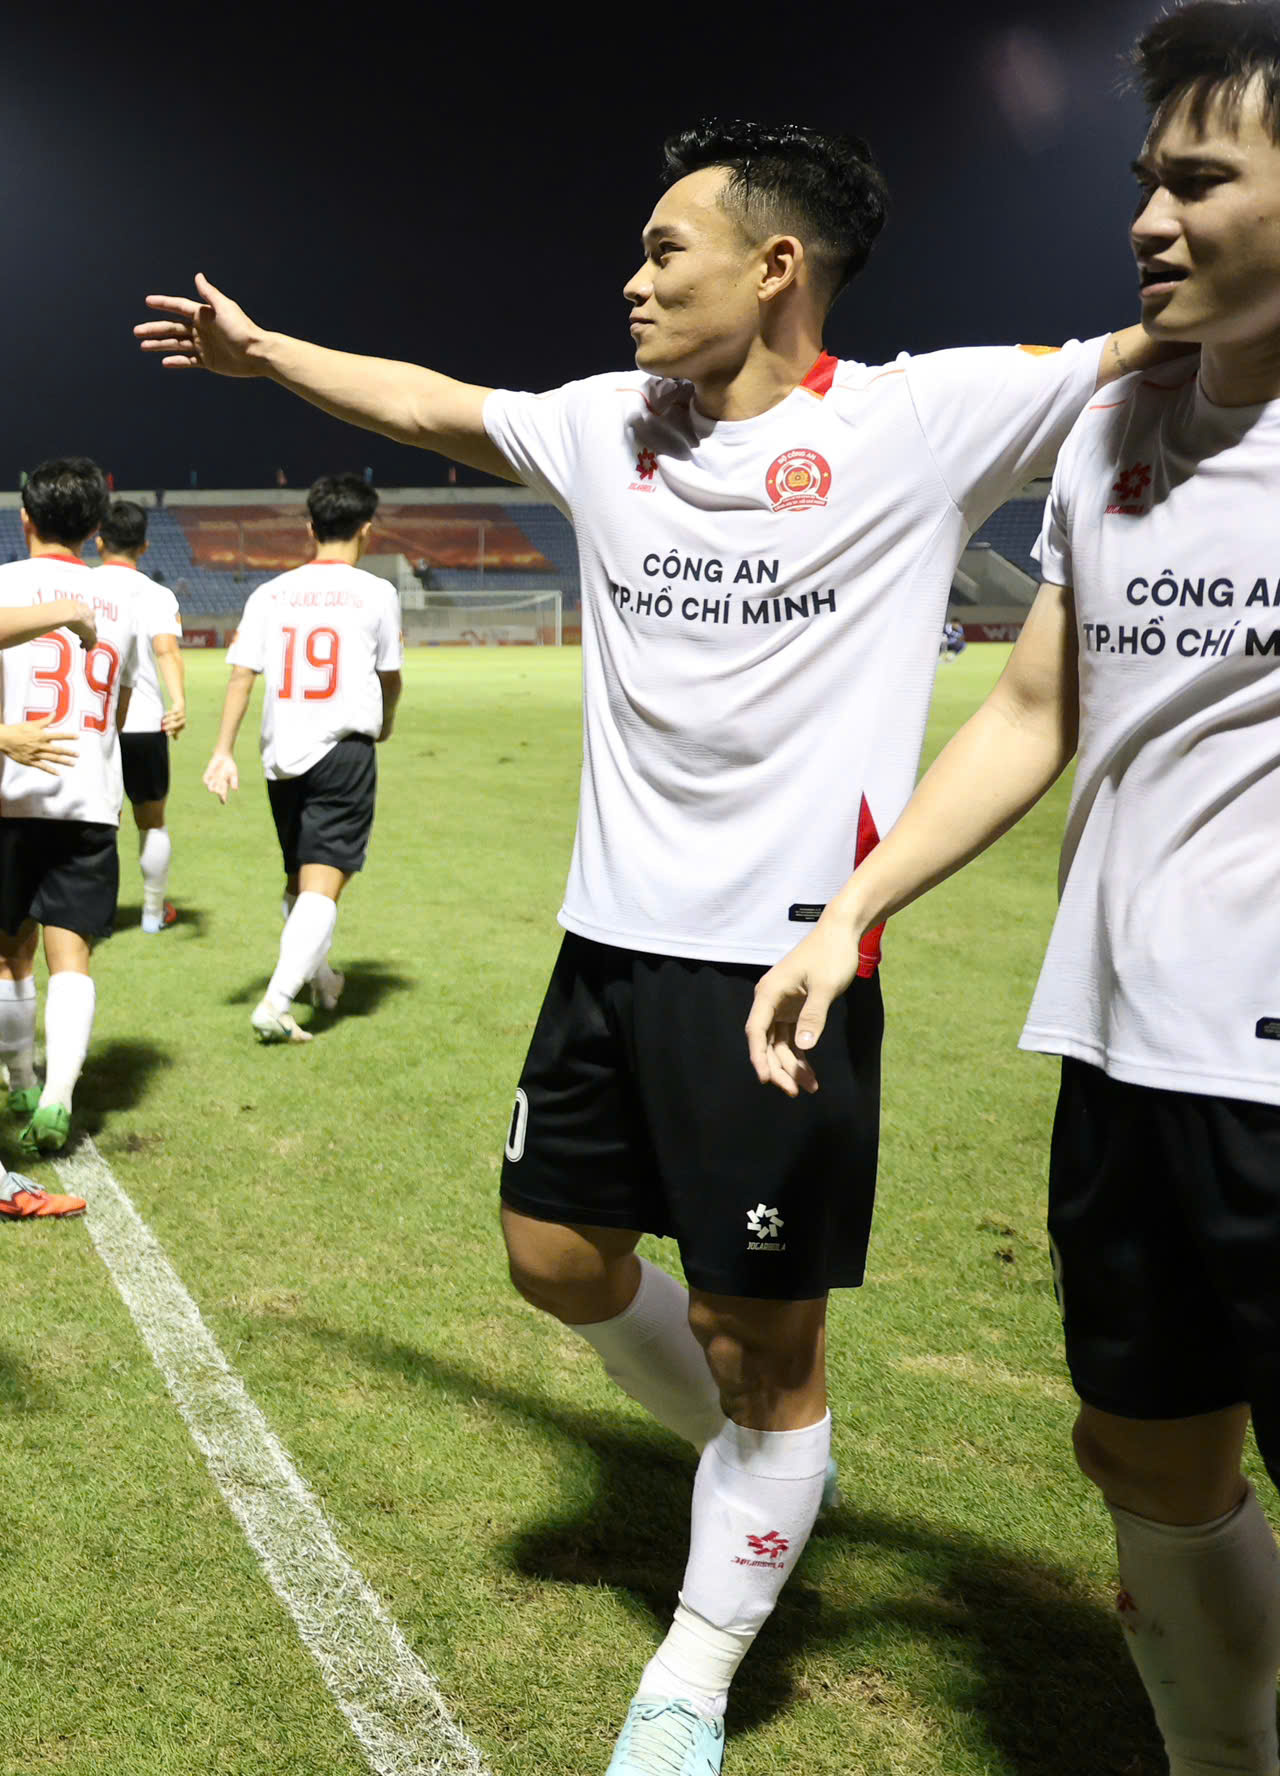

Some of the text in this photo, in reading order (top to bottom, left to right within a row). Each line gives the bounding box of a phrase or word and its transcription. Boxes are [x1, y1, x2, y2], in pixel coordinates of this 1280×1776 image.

[643, 549, 779, 584] CÔNG AN
[681, 593, 732, 624] CHÍ
[742, 589, 837, 624] MINH
[1126, 569, 1234, 607] CÔNG
[1083, 616, 1166, 655] TP.HỒ
[1176, 620, 1241, 657] CHÍ
[277, 625, 341, 701] 19
[23, 630, 121, 737] 39
